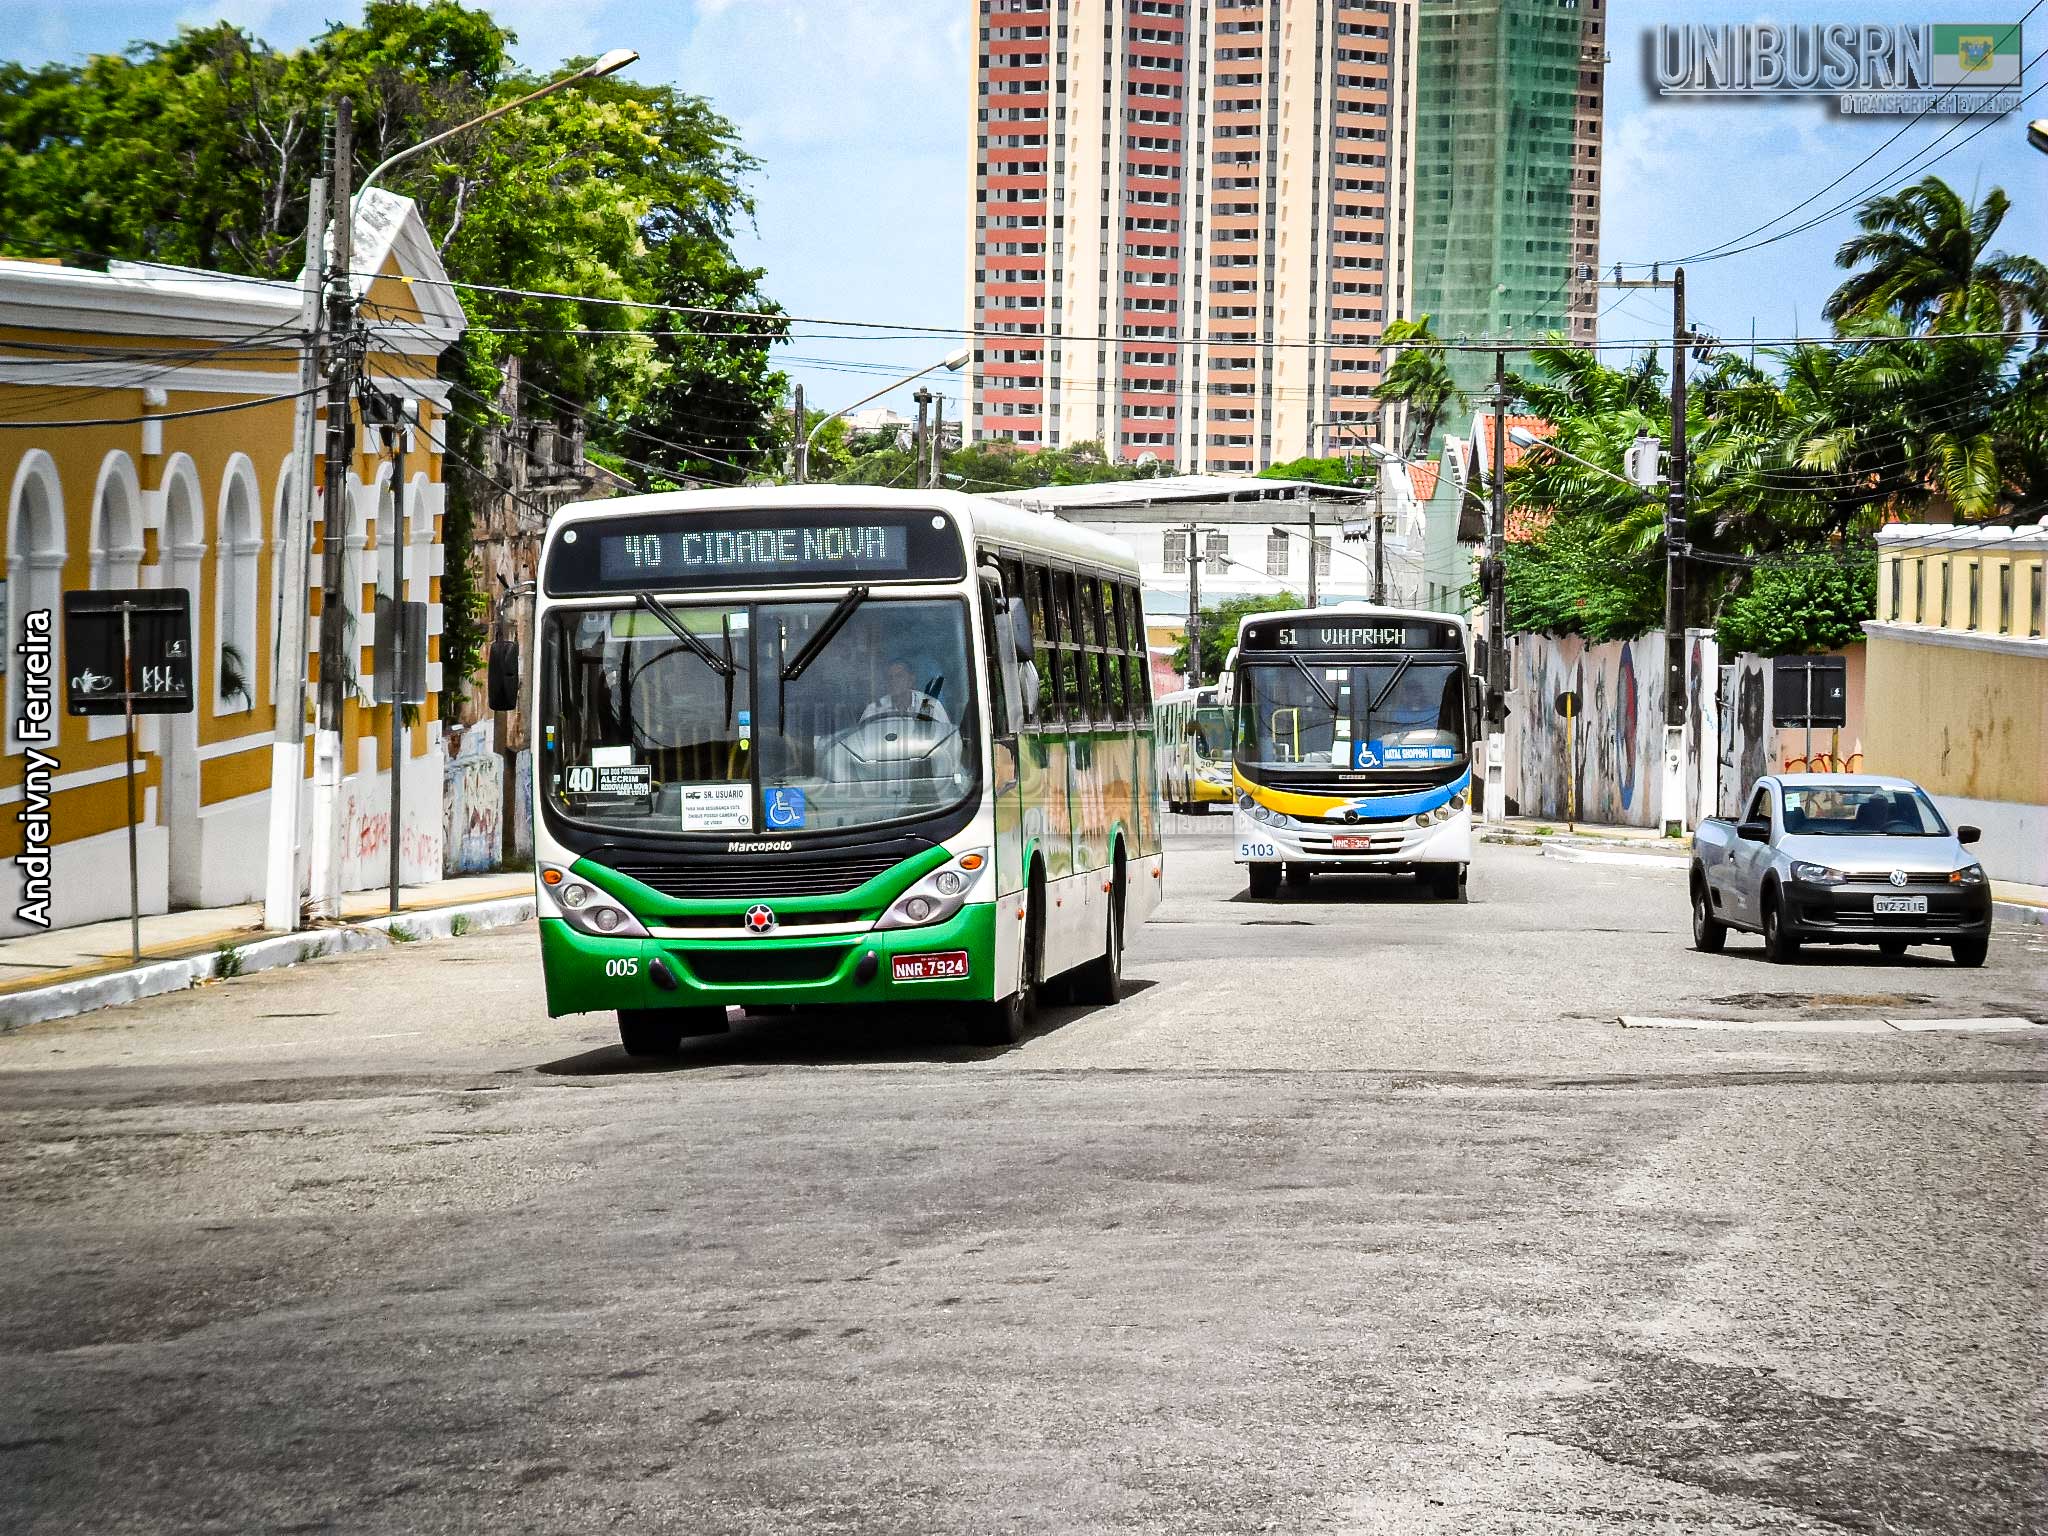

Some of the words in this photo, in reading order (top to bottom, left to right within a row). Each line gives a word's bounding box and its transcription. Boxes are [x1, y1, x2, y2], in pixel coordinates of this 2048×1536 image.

[625, 534, 661, 567] 40
[682, 529, 798, 565] CIDADE
[803, 526, 886, 560] NOVA
[1279, 628, 1298, 644] 51
[569, 767, 593, 792] 40
[601, 775, 639, 783] ALECRIM
[715, 790, 744, 799] USUÁRIO
[728, 839, 792, 854] Marcopolo
[1241, 843, 1274, 857] 5103
[605, 957, 638, 977] 005
